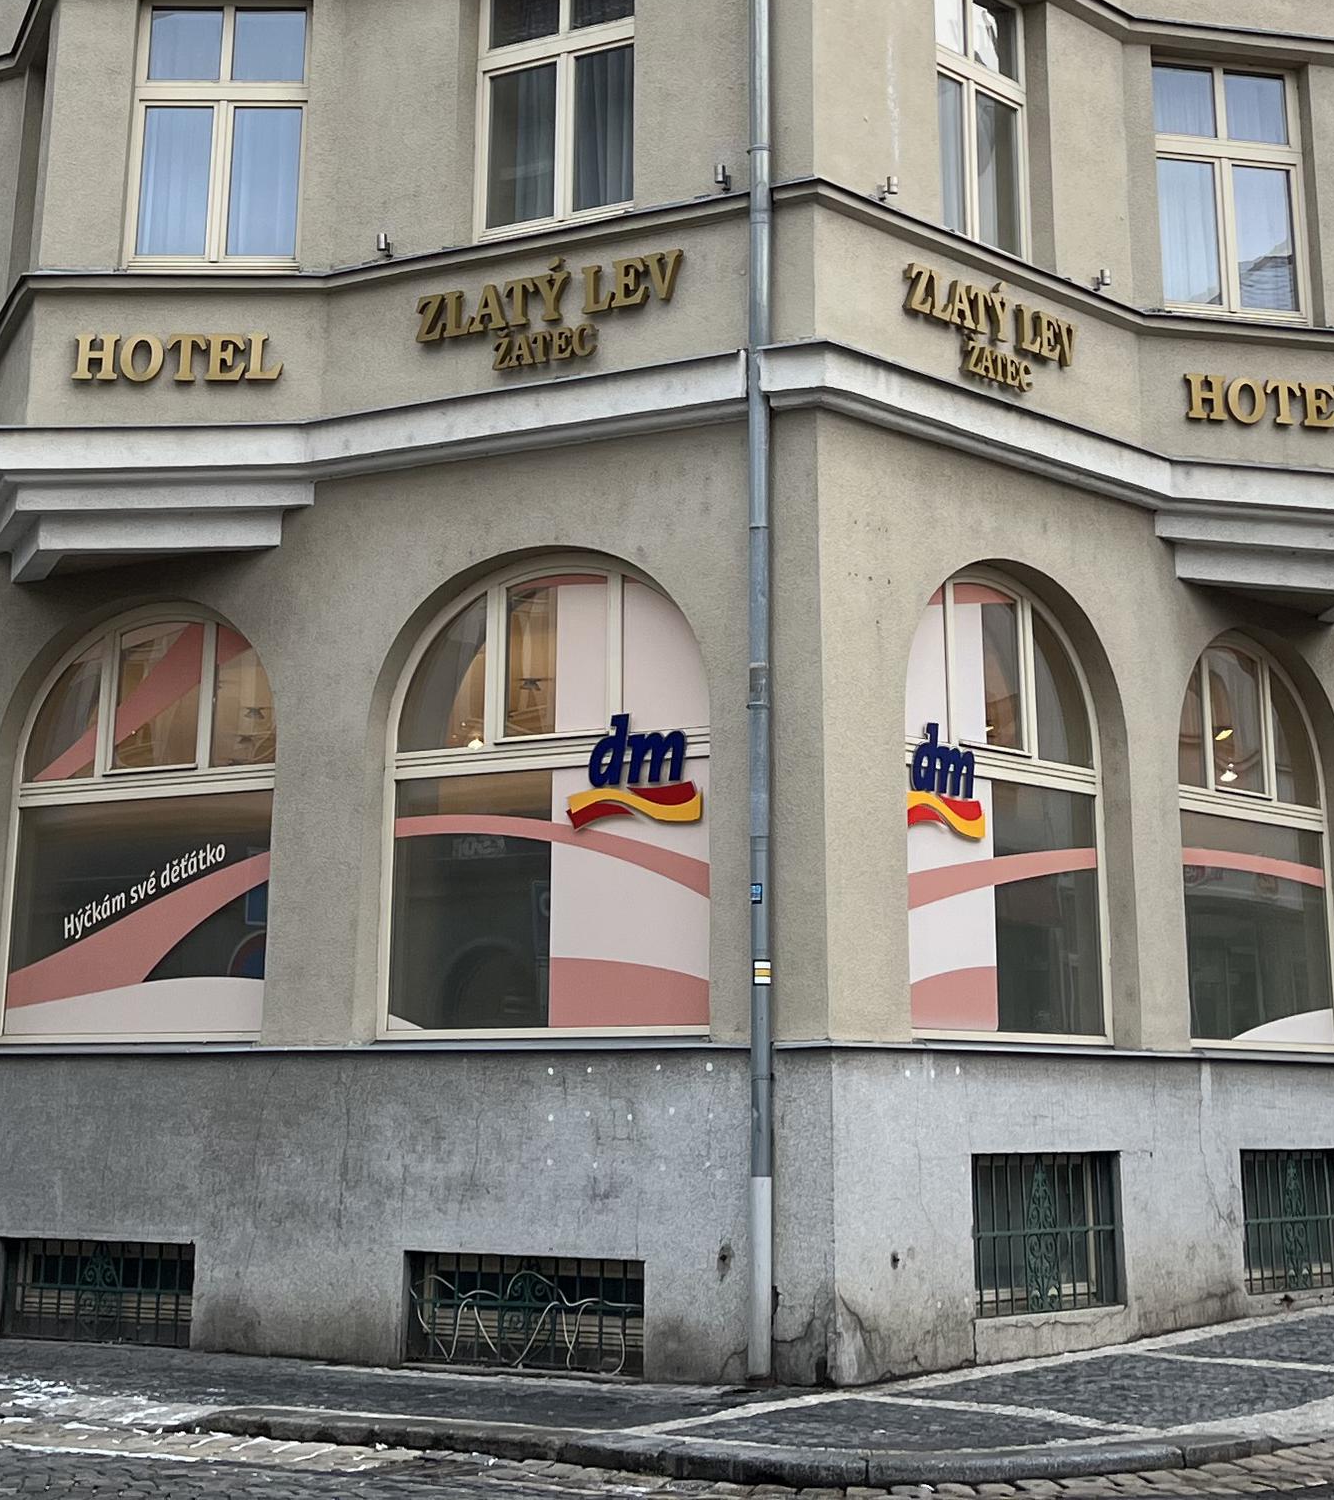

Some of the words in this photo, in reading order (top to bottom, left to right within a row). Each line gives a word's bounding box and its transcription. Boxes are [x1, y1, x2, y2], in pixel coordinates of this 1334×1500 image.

[416, 256, 571, 343] ZLATÝ
[581, 249, 684, 315] LEV
[903, 263, 1010, 342] ZLATÝ
[1015, 303, 1078, 368] LEV
[71, 333, 284, 382] HOTEL
[492, 324, 598, 371] ŽATEC
[960, 331, 1034, 393] ŽATEC
[588, 713, 686, 788] dm
[911, 722, 975, 799] dm
[64, 894, 126, 940] Hýčkám
[130, 870, 156, 904] své
[160, 843, 226, 889] děťátko
